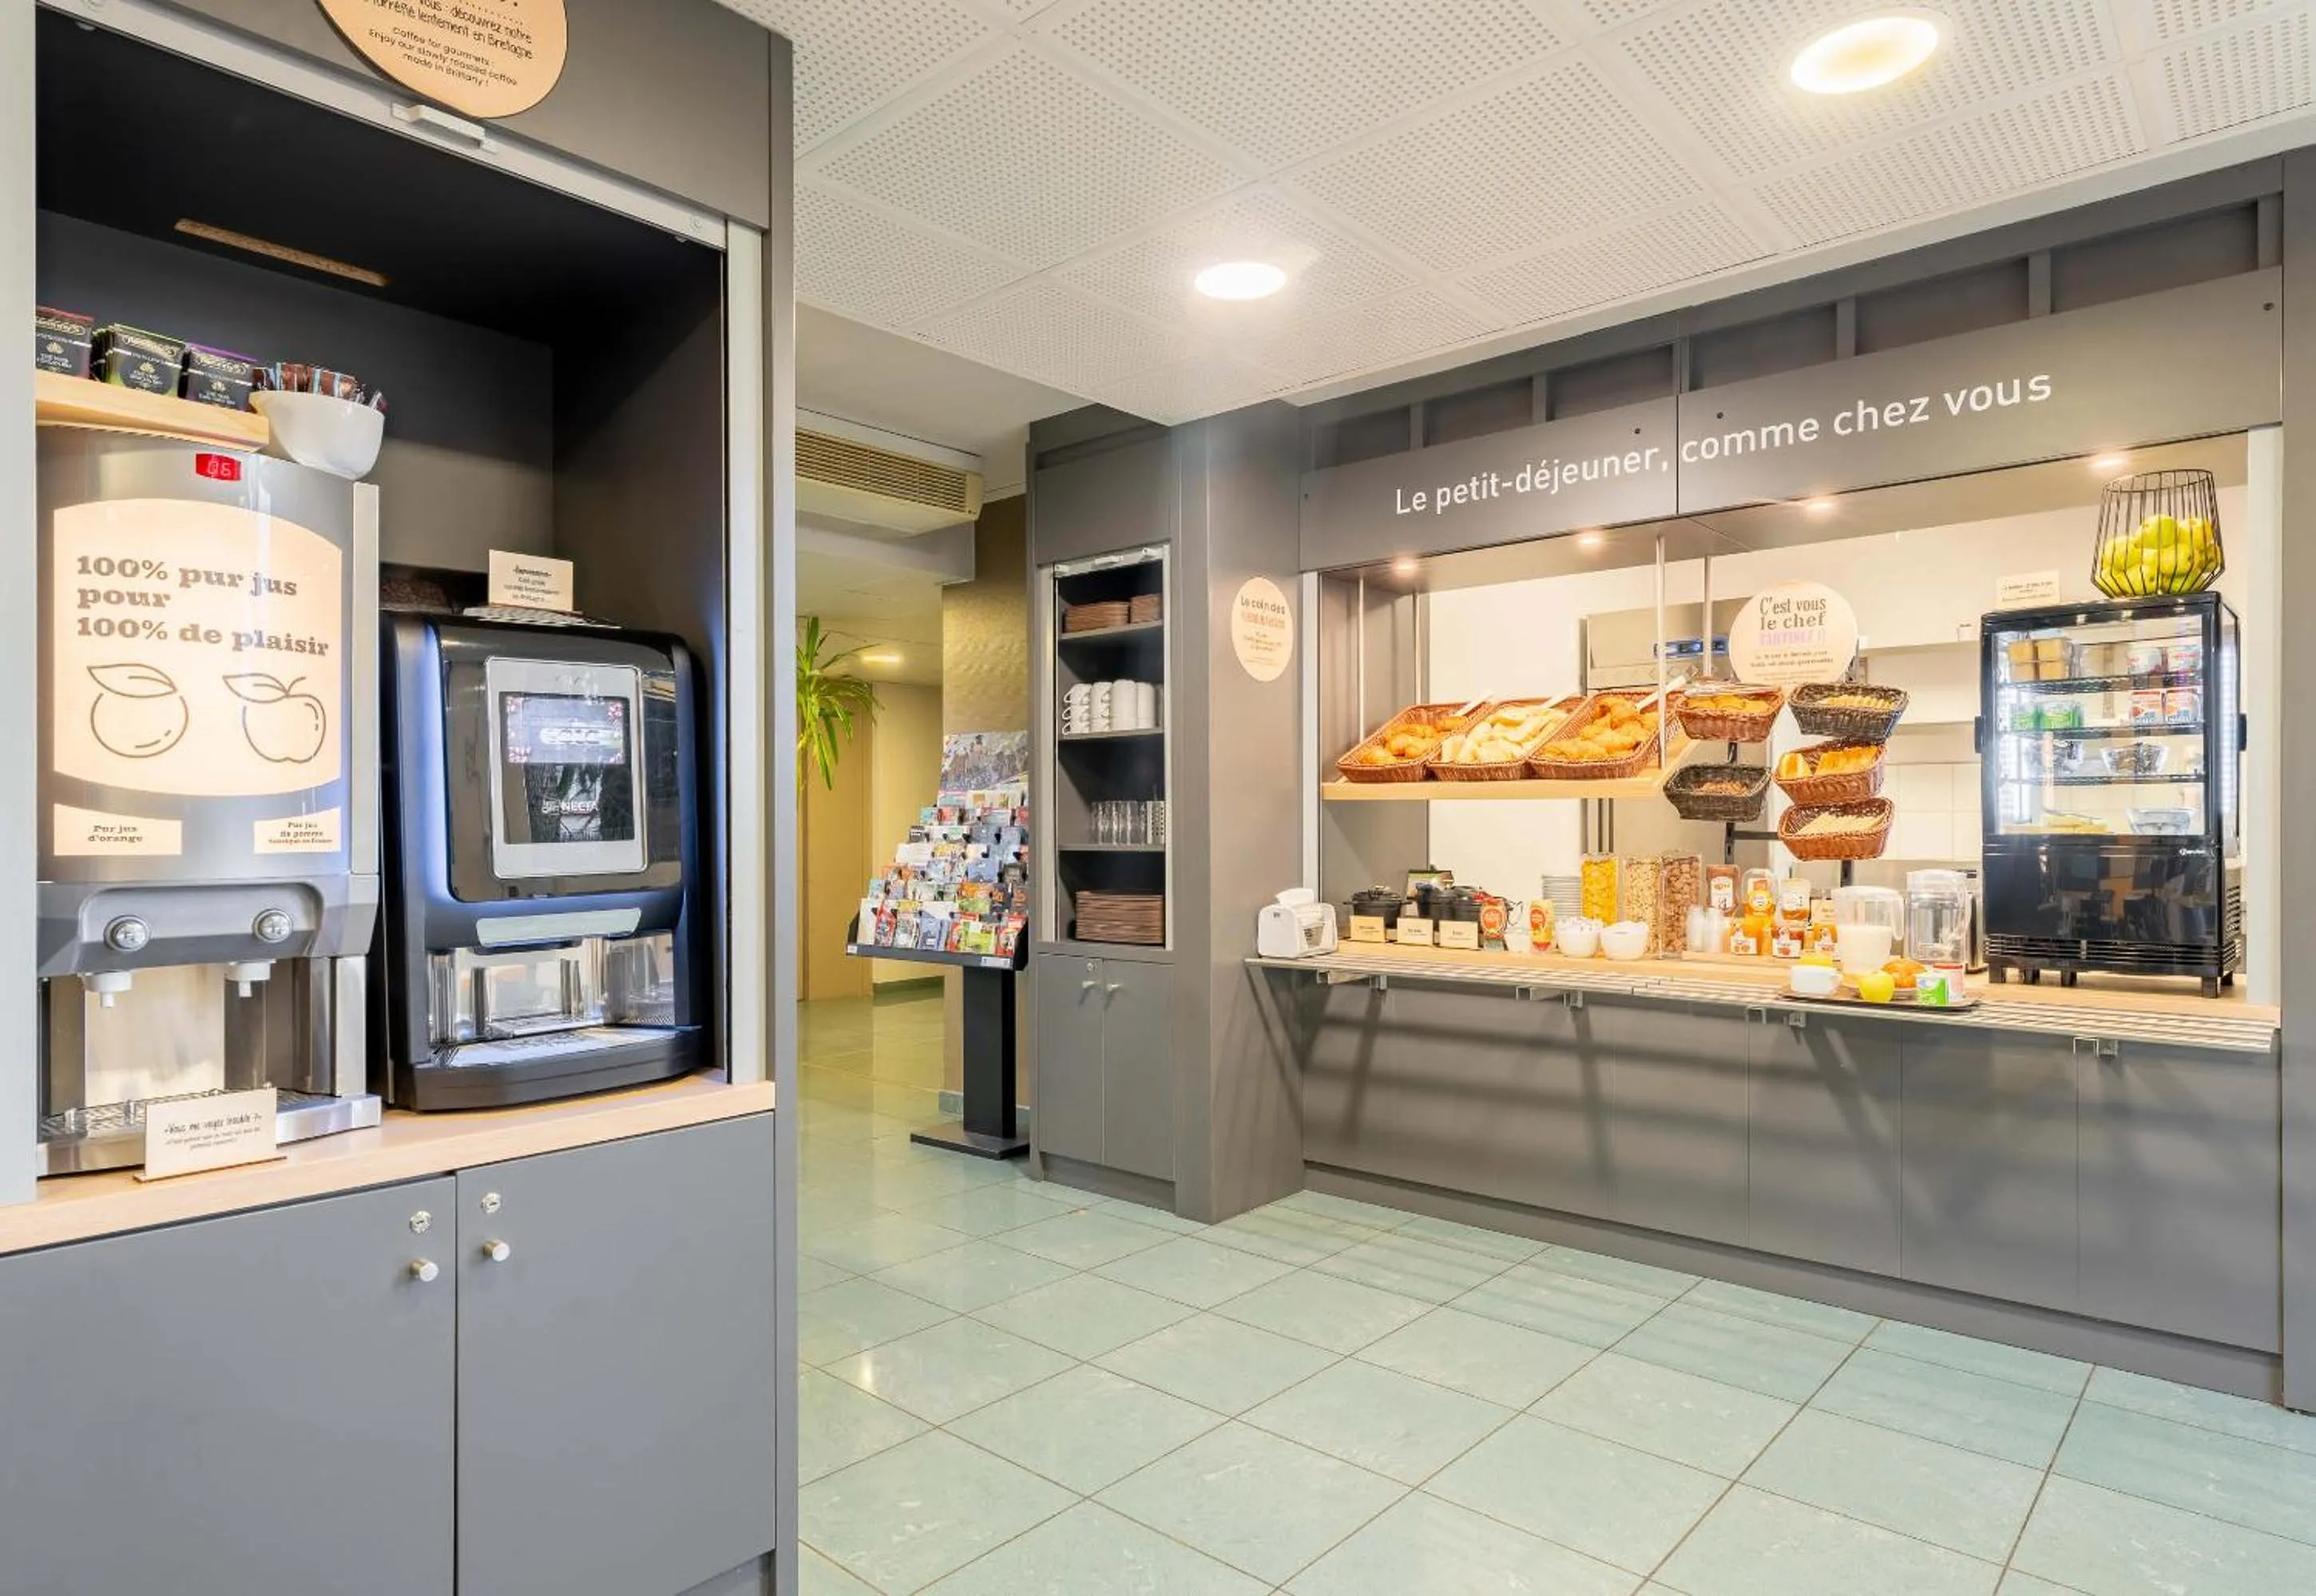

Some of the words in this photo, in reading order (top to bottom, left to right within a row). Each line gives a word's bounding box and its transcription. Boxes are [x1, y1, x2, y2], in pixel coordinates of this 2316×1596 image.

[369, 29, 396, 46] Enjoy
[418, 7, 469, 38] lentement
[473, 32, 486, 43] en
[488, 34, 533, 59] Bretagne
[1395, 487, 1428, 515] Le
[1435, 446, 1670, 516] petit-déjeuner,
[1680, 415, 1821, 464] comme
[1833, 394, 1930, 437] chez
[1943, 373, 2052, 417] vous
[77, 556, 169, 581] 100%
[178, 567, 244, 588] pur
[251, 571, 298, 596] jus
[77, 586, 171, 609] pour
[1759, 596, 1791, 616] C'est
[1795, 598, 1826, 612] vous
[1760, 616, 1777, 631] le
[1783, 611, 1827, 629] chef
[77, 616, 169, 641] 100%
[178, 623, 223, 645] de
[231, 629, 329, 657] plaisir
[88, 834, 143, 844] d'orange
[117, 825, 137, 834] jus
